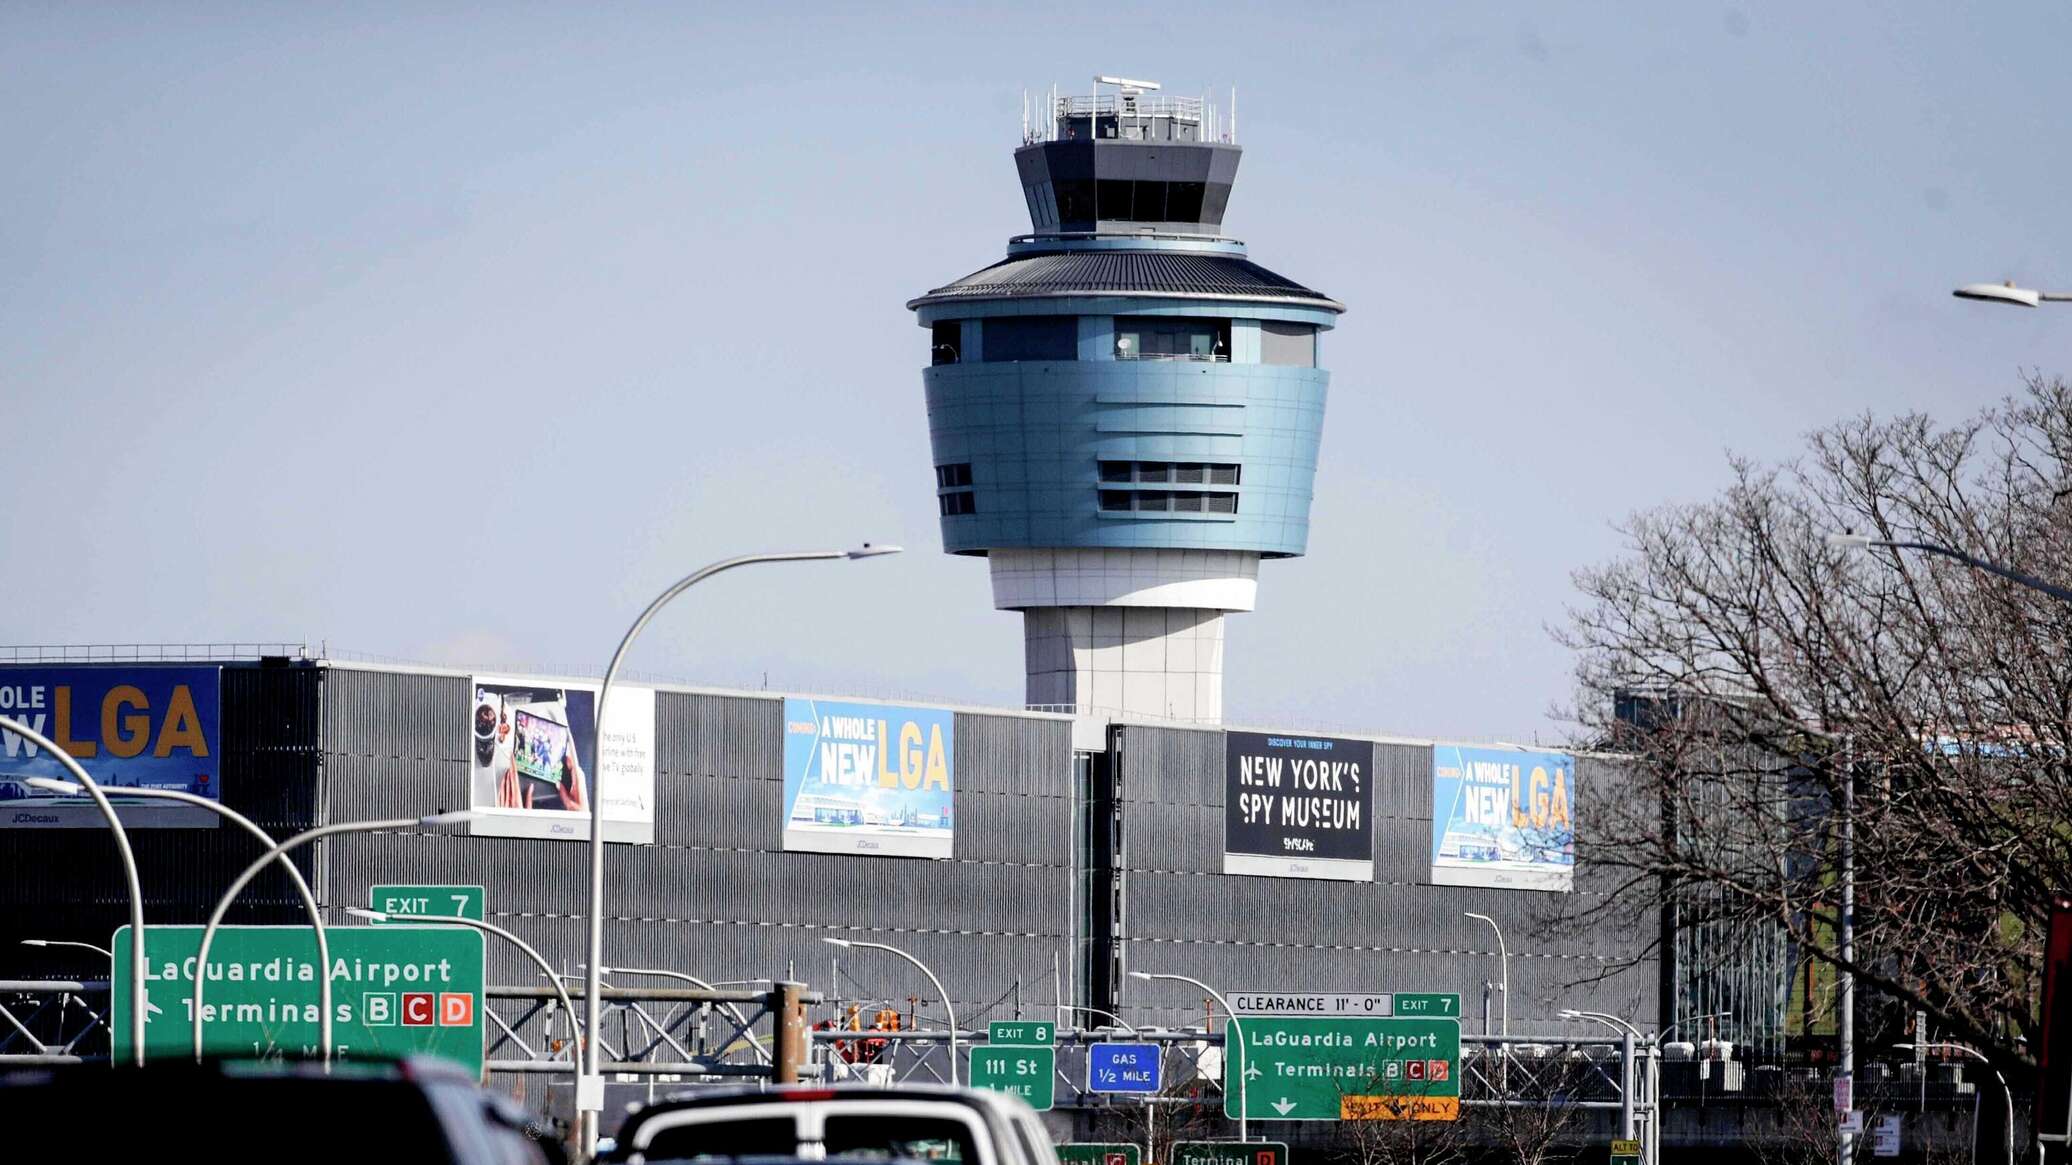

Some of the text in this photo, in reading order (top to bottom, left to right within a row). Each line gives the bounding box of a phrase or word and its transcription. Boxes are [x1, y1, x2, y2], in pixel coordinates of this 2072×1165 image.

[54, 685, 209, 758] LGA
[821, 715, 831, 738] A
[832, 716, 875, 741] WHOLE
[821, 719, 950, 792] NEW LGA
[1240, 755, 1360, 793] NEW YORK'S
[1465, 761, 1474, 782] A
[1474, 762, 1510, 785] WHOLE
[1465, 764, 1570, 831] NEW LGA
[12, 813, 59, 824] JCDecaux
[1239, 792, 1360, 830] SPY MUSEUM
[386, 895, 470, 918] EXIT 7
[329, 957, 452, 986] Airport
[182, 998, 466, 1022] Terminas B C D
[1237, 997, 1325, 1011] CLEARANCE
[1402, 998, 1452, 1013] EXIT 7
[997, 1026, 1047, 1041] EXIT 8
[1252, 1031, 1437, 1050] LaGuardia Airport
[986, 1059, 1038, 1075] 111 St
[1112, 1054, 1137, 1064] GAS
[1275, 1061, 1375, 1077] Terminals
[1386, 1063, 1399, 1077] B
[1409, 1062, 1420, 1078] C
[1099, 1068, 1151, 1083] 1/2 MILE
